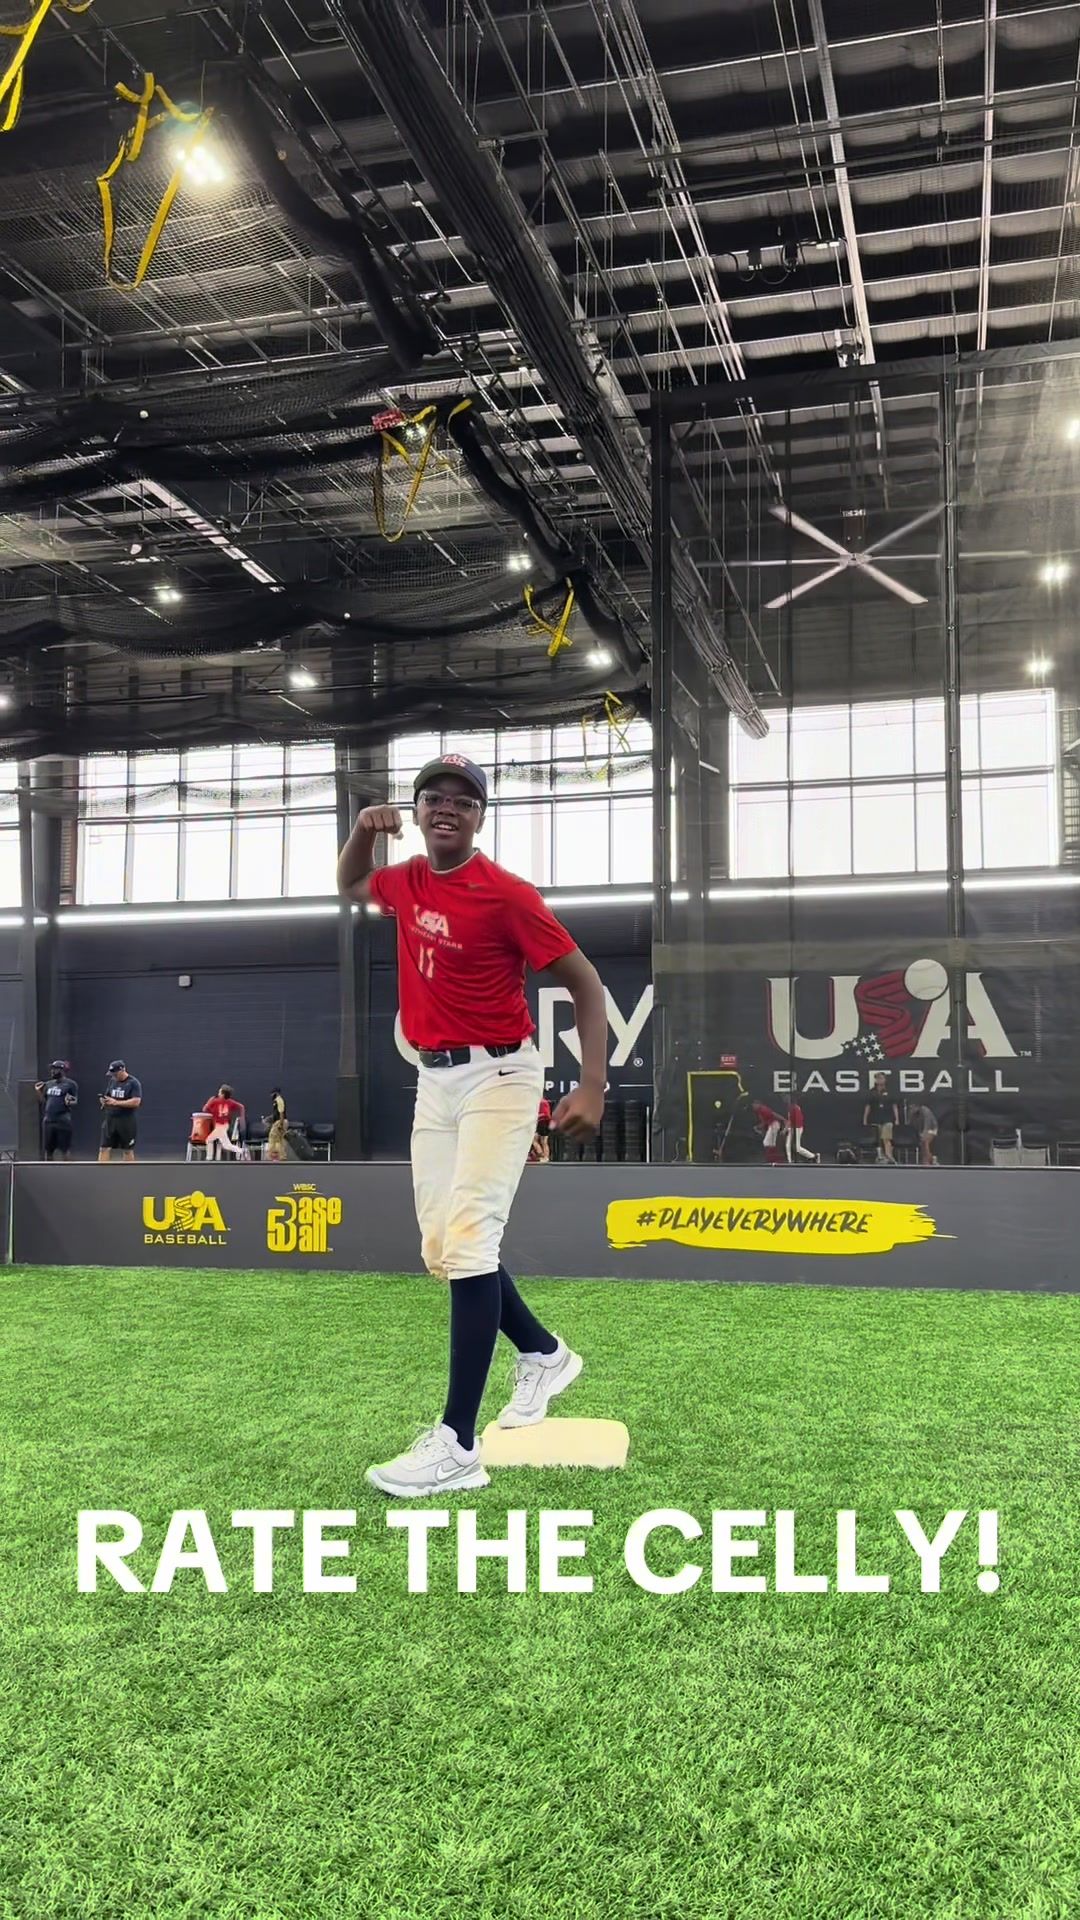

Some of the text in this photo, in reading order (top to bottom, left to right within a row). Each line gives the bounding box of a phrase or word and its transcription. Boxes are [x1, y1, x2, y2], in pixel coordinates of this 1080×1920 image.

[766, 960, 1019, 1060] USA
[142, 1191, 227, 1231] USA
[636, 1207, 872, 1234] #PLAYEVERYWHERE
[144, 1234, 228, 1245] BASEBALL
